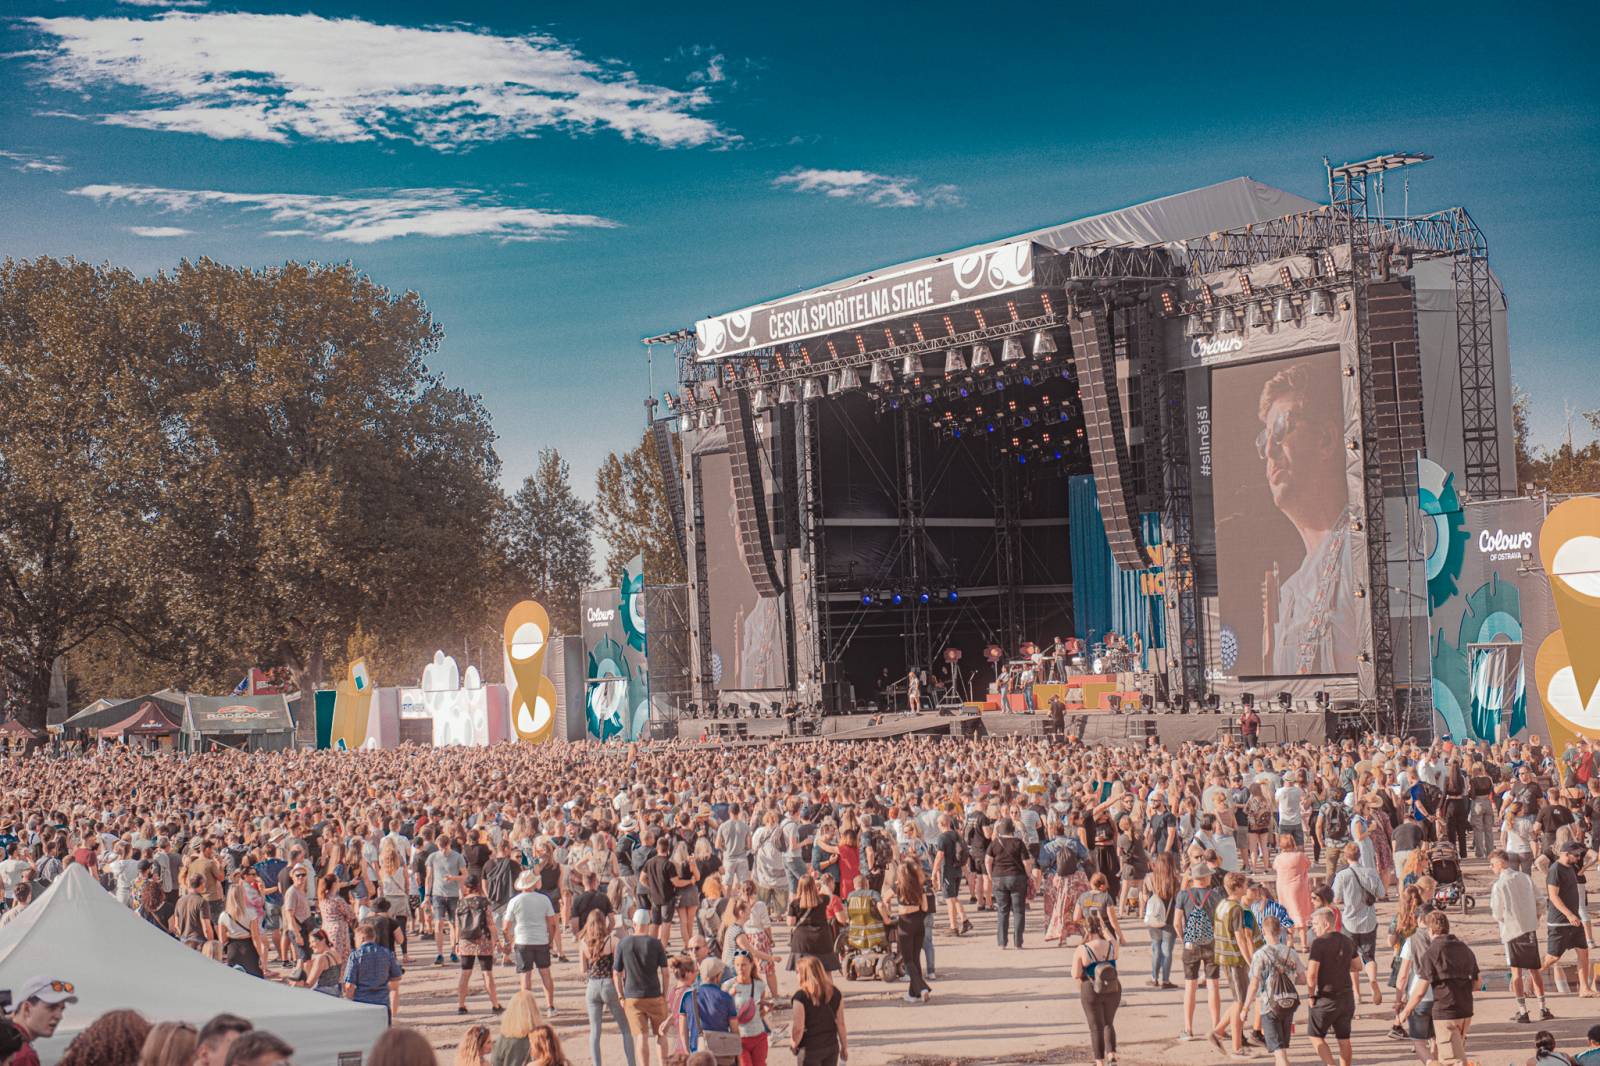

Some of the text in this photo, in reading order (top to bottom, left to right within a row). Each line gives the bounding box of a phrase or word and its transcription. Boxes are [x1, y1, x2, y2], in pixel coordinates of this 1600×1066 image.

[768, 276, 935, 340] ČESKÁ SPOŘITELNA STAGE
[1191, 335, 1243, 358] Colours
[1196, 405, 1212, 477] #silnější
[1479, 529, 1533, 552] Colours
[587, 607, 615, 622] Colours
